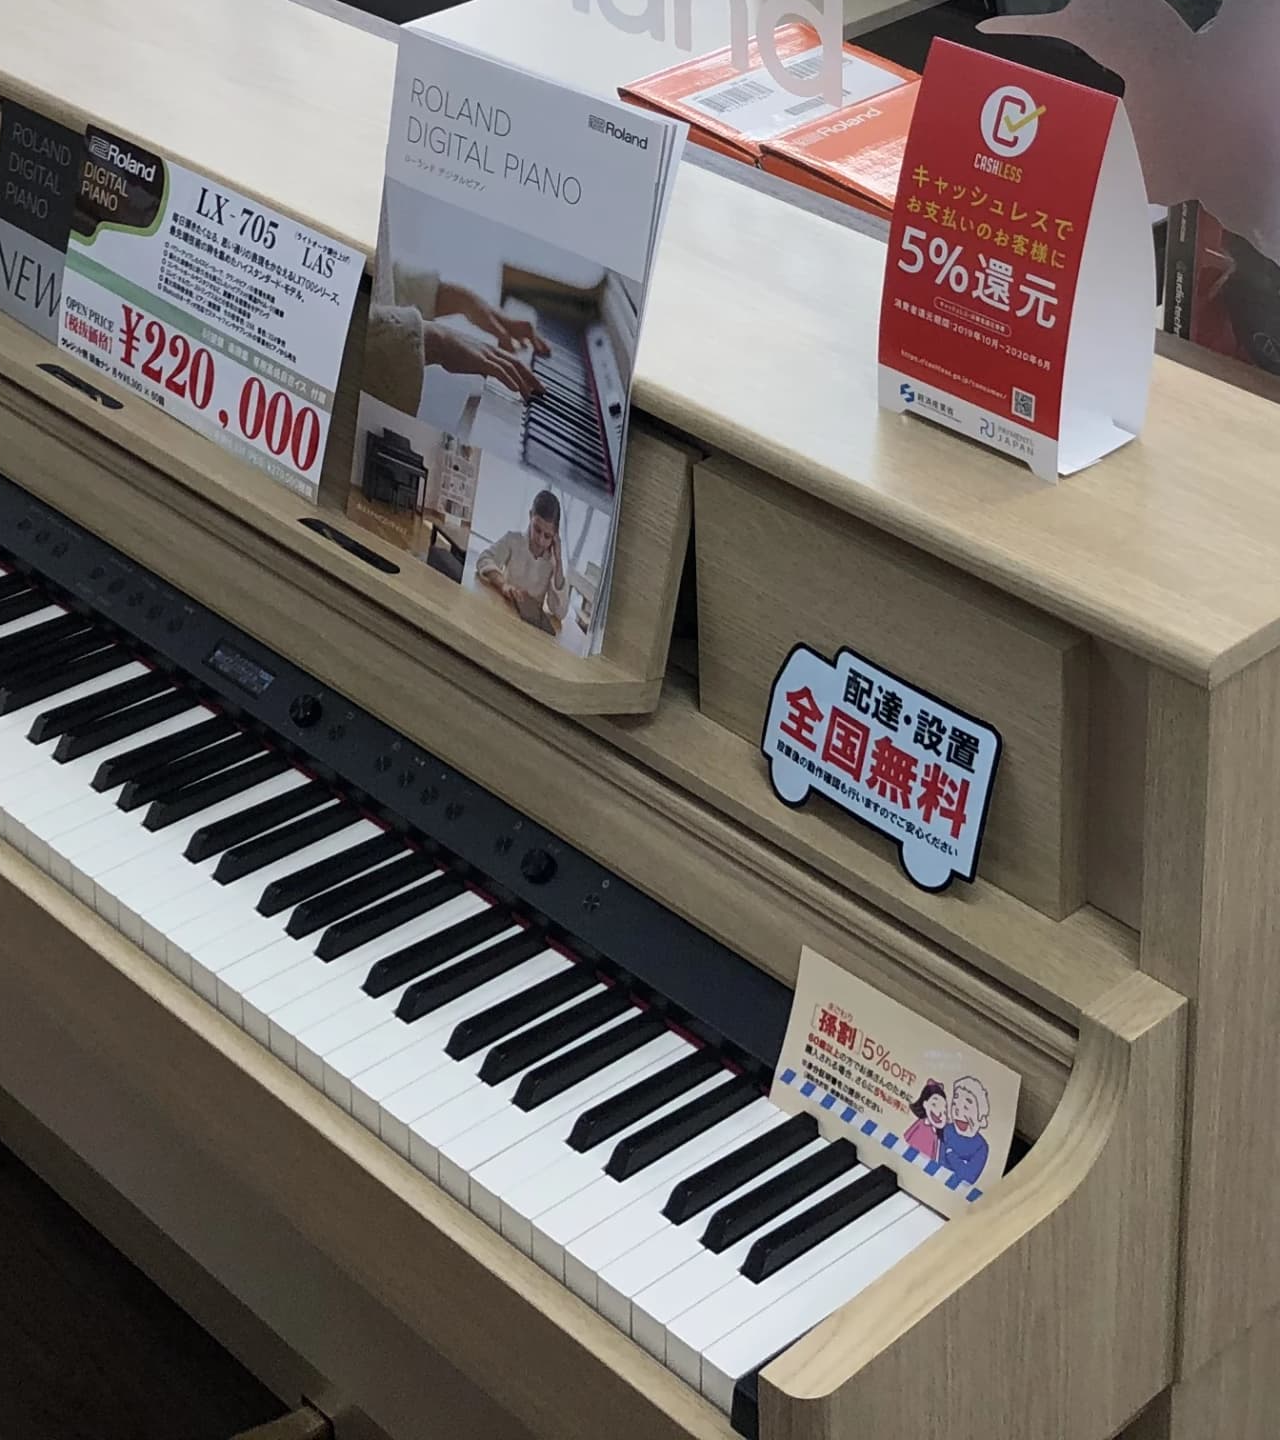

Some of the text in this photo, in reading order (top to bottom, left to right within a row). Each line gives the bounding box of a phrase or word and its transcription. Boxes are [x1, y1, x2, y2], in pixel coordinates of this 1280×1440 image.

[410, 77, 512, 138] ROLAND
[816, 106, 883, 138] Roland
[10, 121, 73, 168] ROLAND
[604, 120, 649, 152] Roland
[7, 151, 62, 197] DIGITAL
[82, 160, 129, 199] DIGITAL
[107, 145, 157, 183] Roland
[406, 114, 583, 206] DIGITAL PIANO
[973, 152, 1025, 184] CASHLESS
[4, 183, 50, 220] PIANO
[80, 180, 119, 213] PIANO
[911, 163, 1076, 242] キャッシュレスで
[906, 195, 1067, 271] お支払いのお客様に
[300, 246, 337, 280] LAS
[896, 223, 1060, 331] 5%還元
[65, 295, 116, 333] OPEN PRICE
[118, 302, 321, 472] ¥220,000
[996, 434, 1035, 457] JAPAN
[842, 667, 981, 775] 配達・設置
[778, 685, 971, 841] 全国無料
[775, 738, 959, 858] 設置後の動作確認も行いますのでご安心ください
[818, 1008, 919, 1087] 孫割 5%OFF
